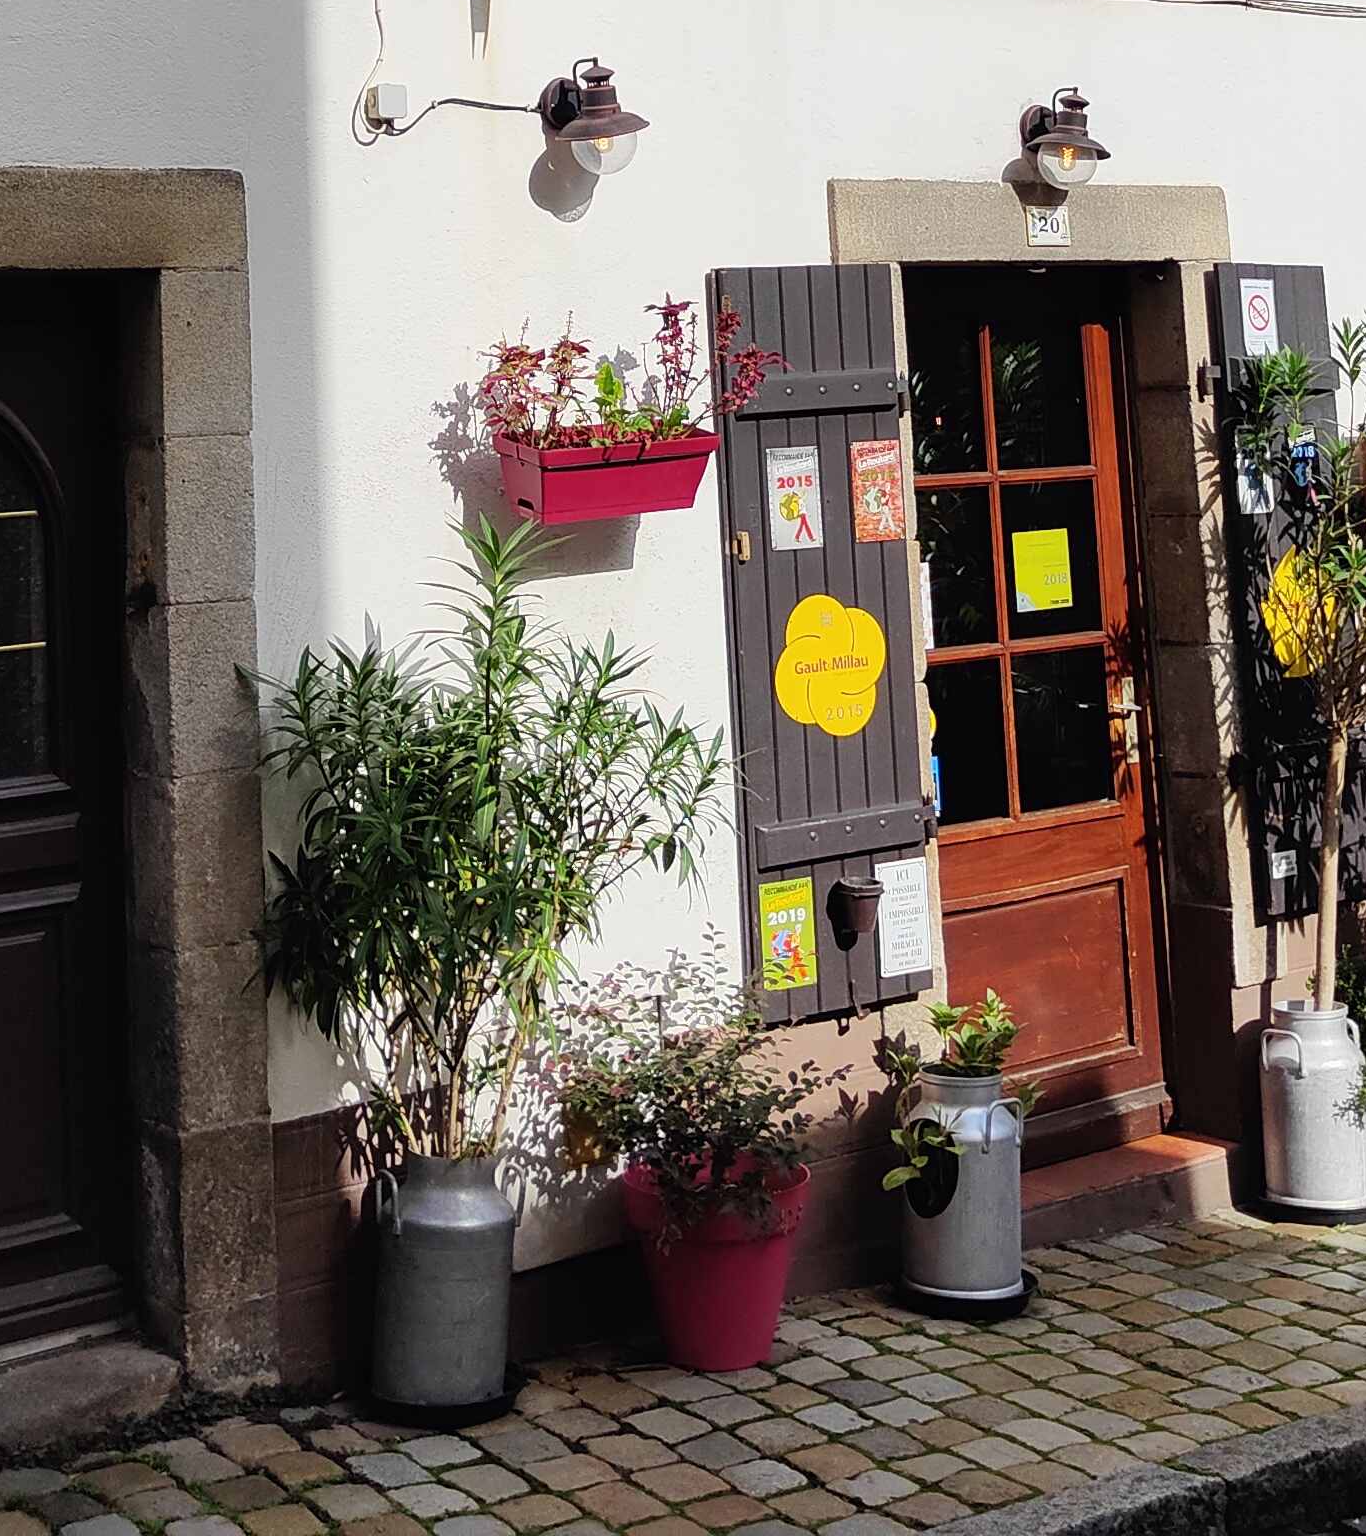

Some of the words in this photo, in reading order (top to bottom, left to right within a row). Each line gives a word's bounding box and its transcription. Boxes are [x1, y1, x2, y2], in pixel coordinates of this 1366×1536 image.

[1038, 216, 1060, 234] 20
[1292, 445, 1315, 458] 2018
[776, 475, 813, 489] 2015
[1044, 572, 1068, 586] 2018
[826, 704, 863, 721] 2015
[896, 868, 910, 882] ICI
[891, 882, 921, 896] POSSIBLE
[767, 907, 806, 926] 2019
[891, 937, 923, 952] MIRACLES
